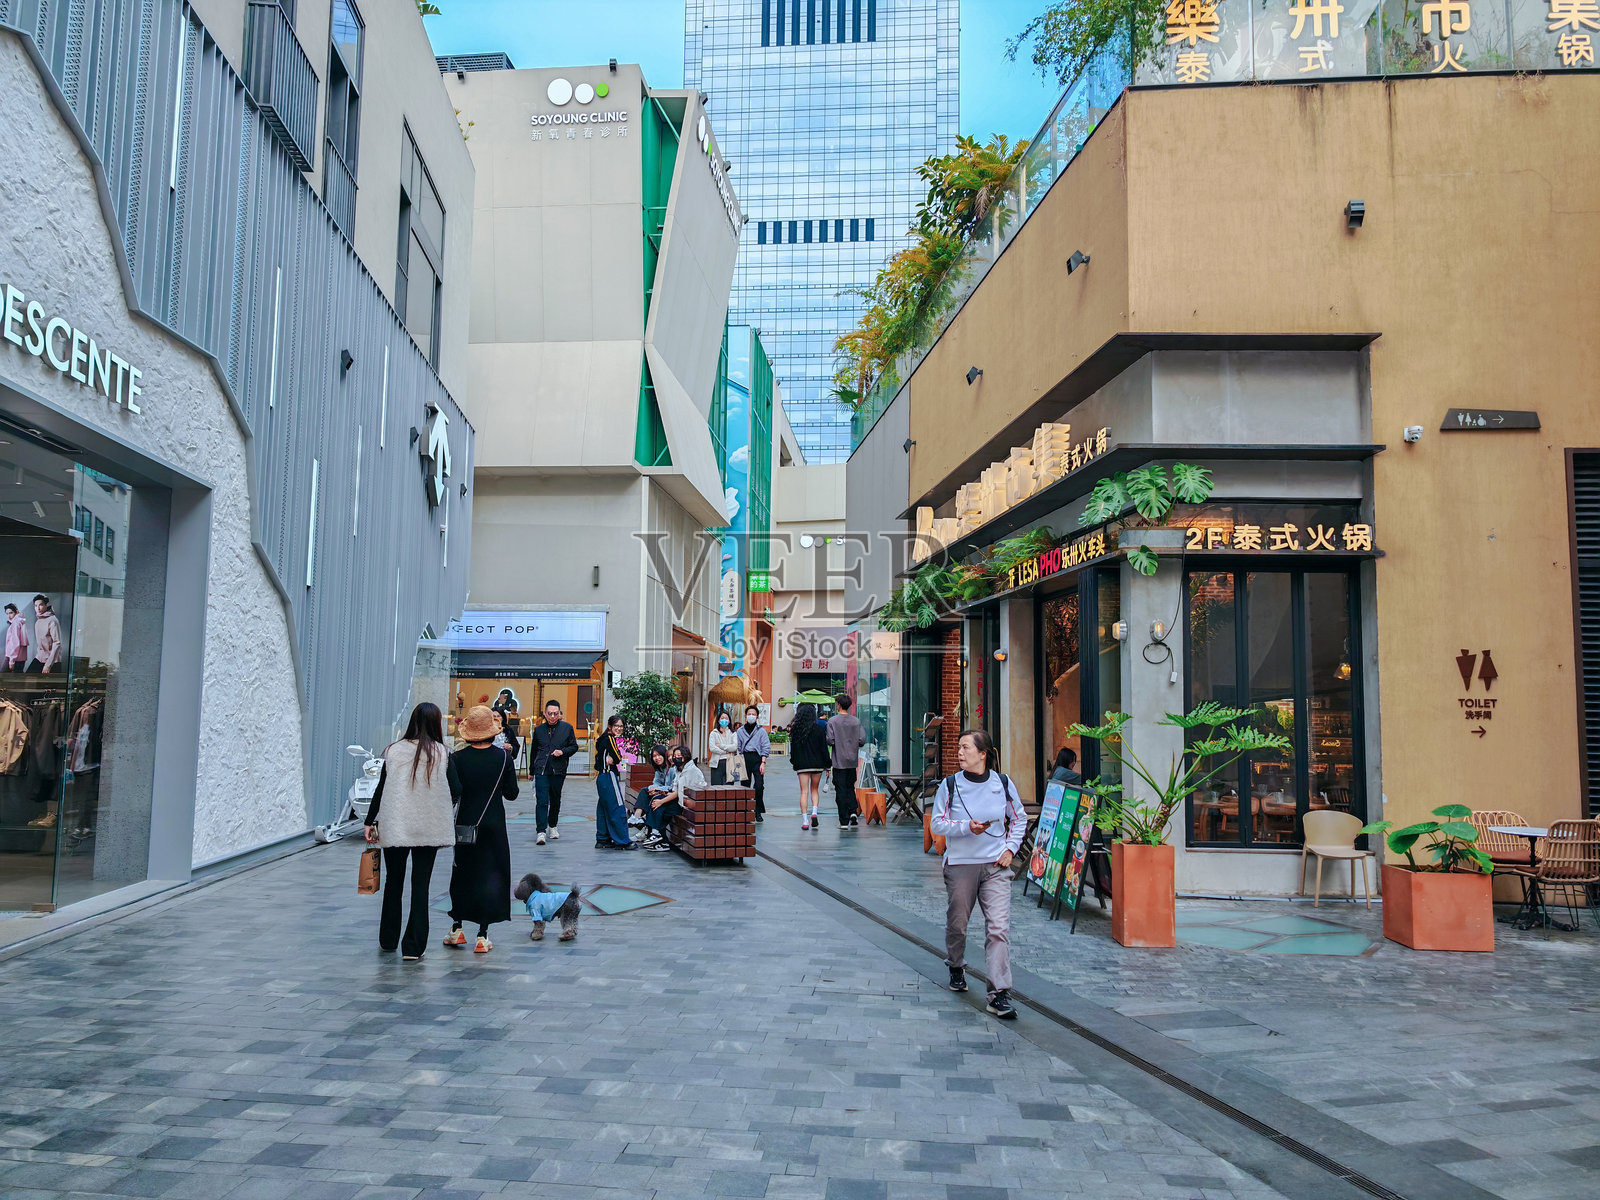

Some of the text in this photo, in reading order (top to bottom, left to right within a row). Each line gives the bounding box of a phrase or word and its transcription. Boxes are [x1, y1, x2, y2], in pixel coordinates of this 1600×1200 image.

[1175, 33, 1596, 83] 泰式火锅
[531, 111, 627, 125] SOYOUNG CLINIC
[0, 283, 143, 415] ESCENTE
[1186, 522, 1372, 551] 2F 泰式火锅
[1018, 557, 1039, 586] LESA
[1040, 547, 1060, 578] PHO
[504, 625, 535, 634] POP
[1458, 698, 1497, 708] TOILET
[1465, 710, 1492, 720] 洗手间
